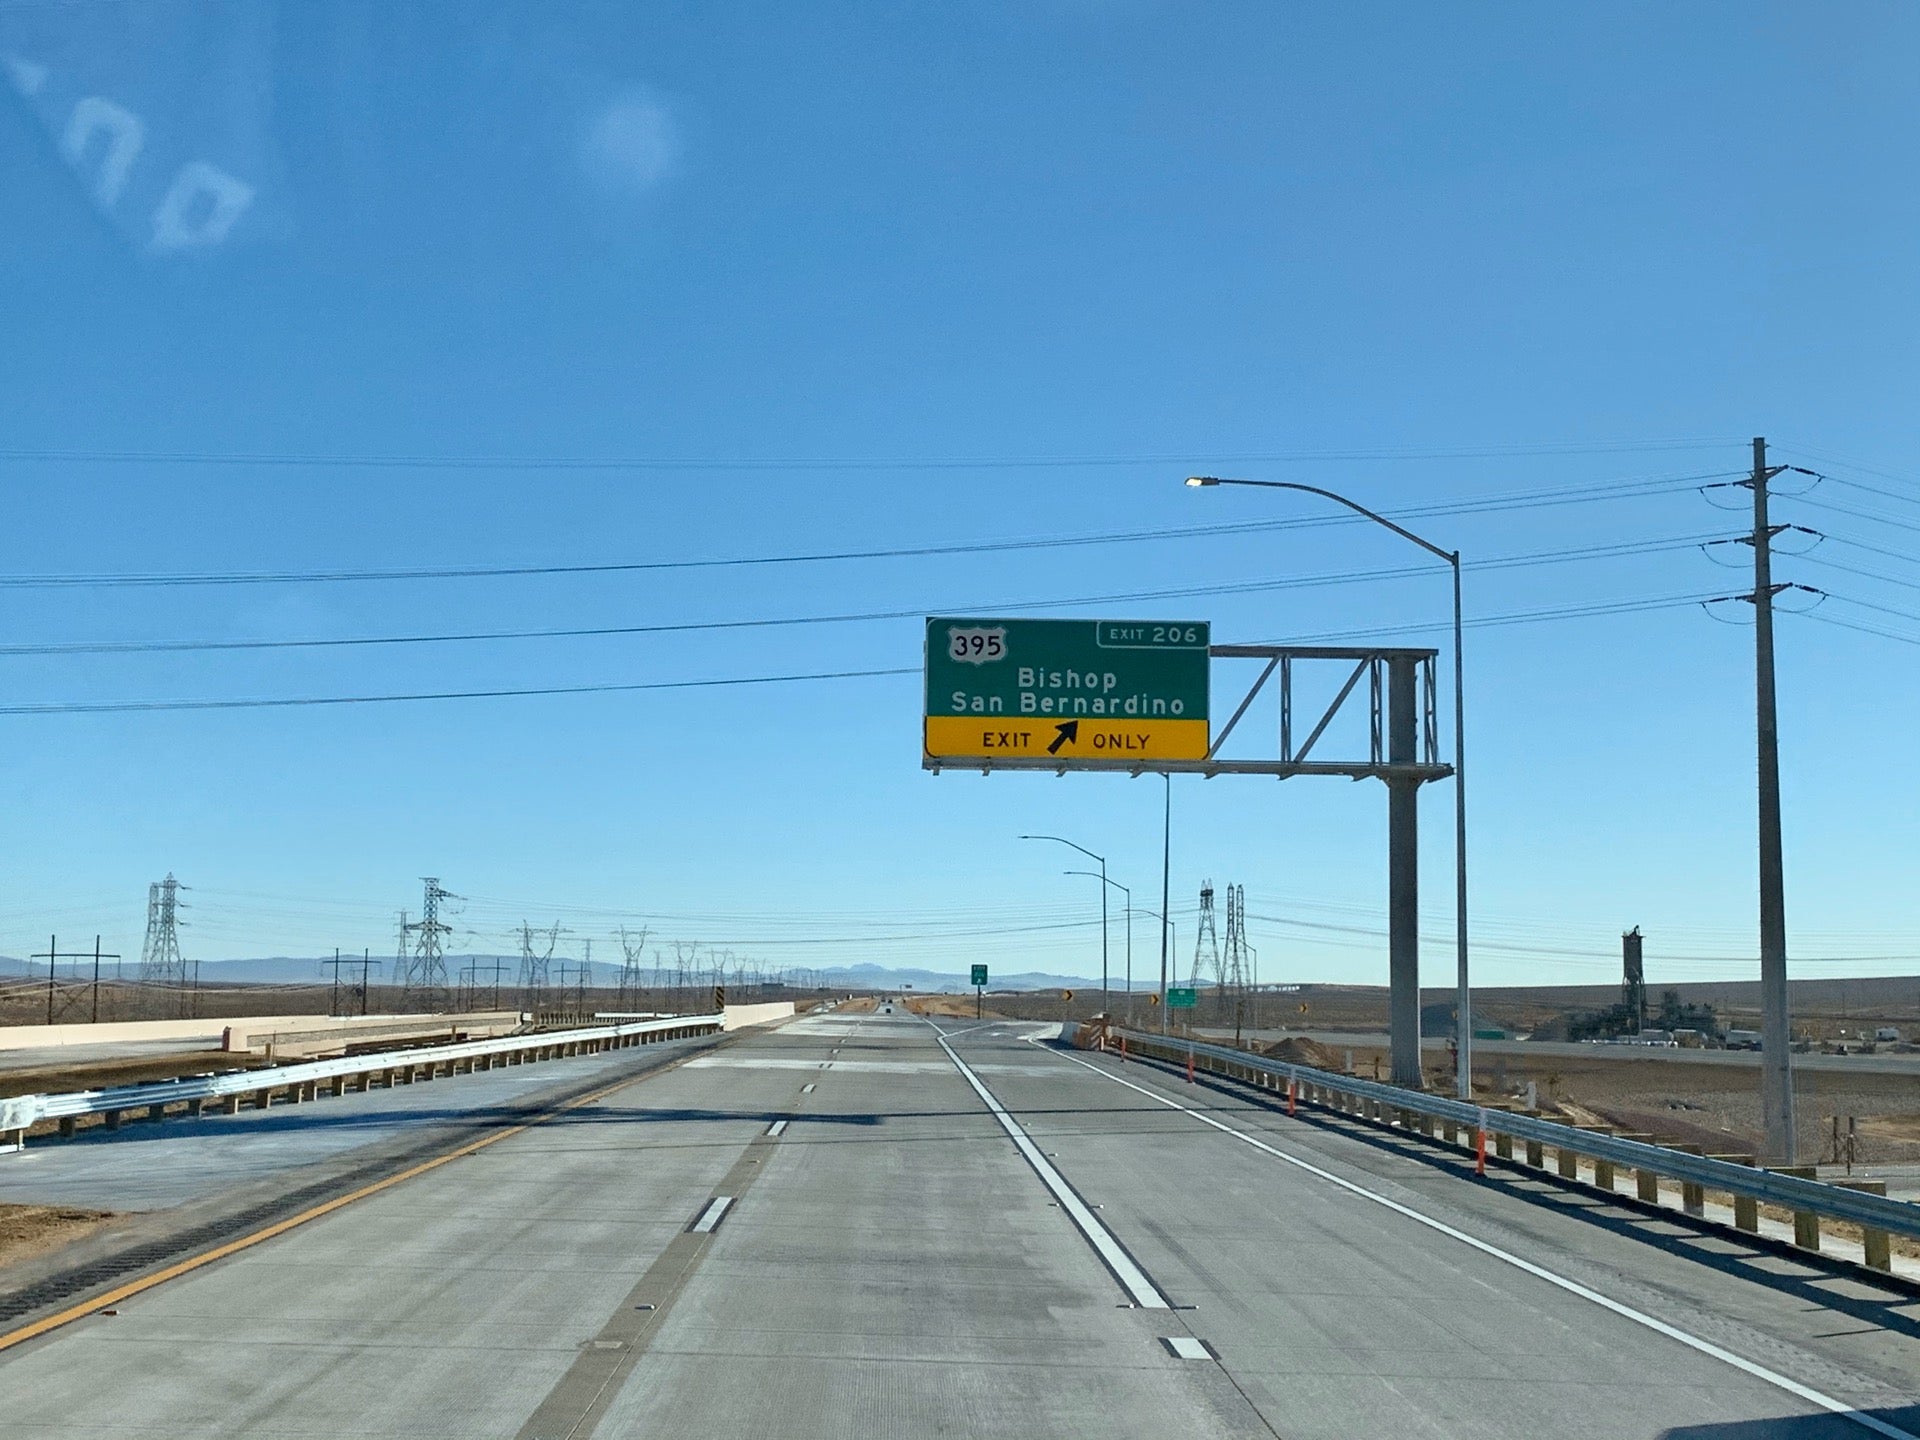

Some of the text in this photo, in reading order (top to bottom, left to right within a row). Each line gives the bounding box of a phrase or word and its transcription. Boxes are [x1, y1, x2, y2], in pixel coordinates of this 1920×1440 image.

[1110, 627, 1198, 642] EXIT 206
[954, 635, 1001, 656] 395
[1018, 667, 1117, 693] Bishop
[951, 691, 1184, 715] San Bernardino
[983, 733, 1151, 750] EXIT ONLY
